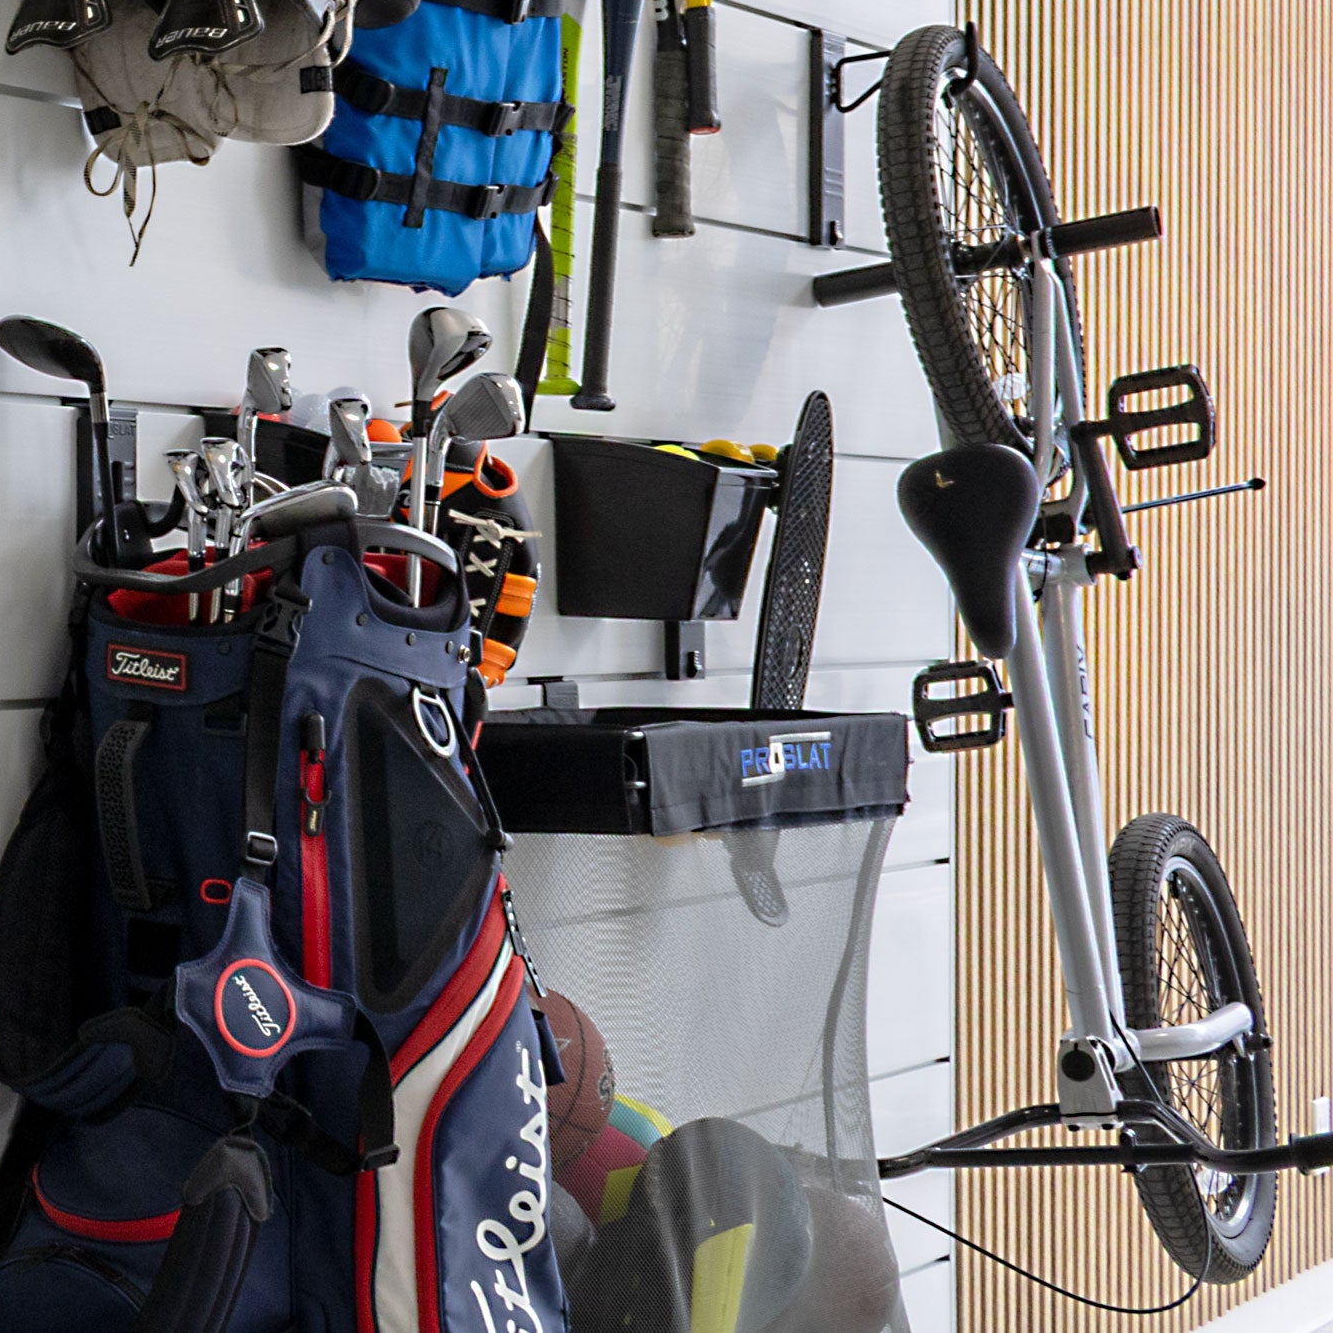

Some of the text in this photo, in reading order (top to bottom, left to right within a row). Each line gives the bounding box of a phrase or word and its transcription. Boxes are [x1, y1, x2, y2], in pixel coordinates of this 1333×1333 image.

[154, 26, 228, 49] BAUER
[111, 651, 180, 684] Titleist
[235, 973, 281, 1036] Titleist
